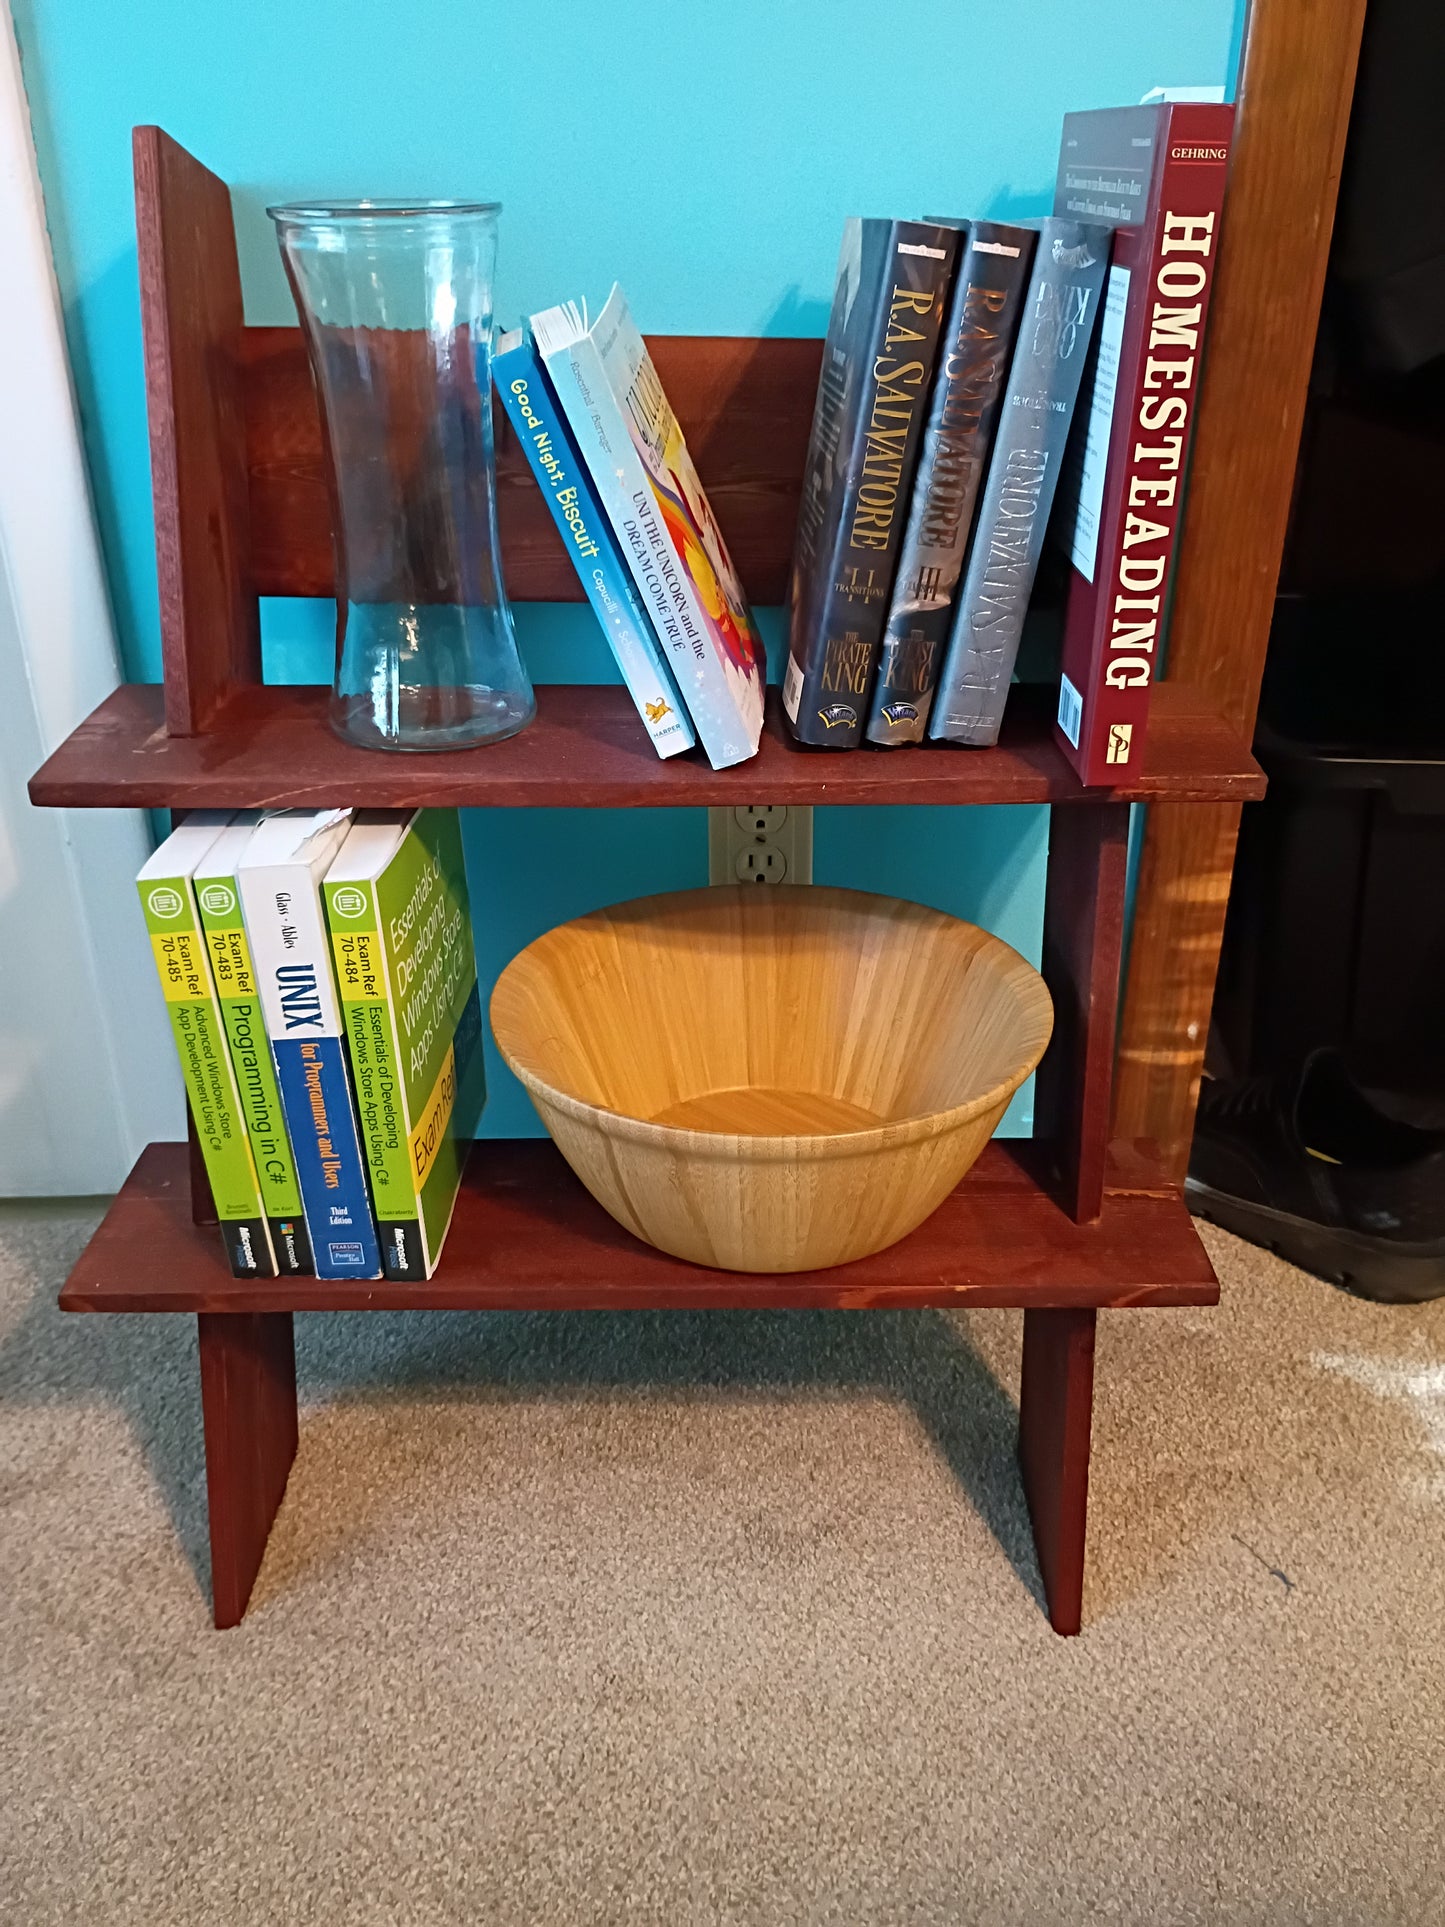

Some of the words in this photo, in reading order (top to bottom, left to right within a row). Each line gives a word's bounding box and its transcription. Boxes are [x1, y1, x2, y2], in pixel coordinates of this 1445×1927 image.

[1172, 148, 1226, 159] GEHRING
[570, 361, 594, 406] Rosenthal
[510, 378, 544, 430] Good
[533, 431, 566, 487] Night,
[556, 486, 600, 558] Biscuit
[850, 356, 925, 550] SALVATORE
[917, 352, 996, 550] SALVATORE
[1105, 210, 1215, 690] HOMESTEADING
[970, 449, 1050, 634] SALVATORE
[592, 568, 618, 614] Capucilli
[623, 520, 654, 572] DREAM
[646, 574, 672, 616] COME
[663, 616, 686, 652] TRUE
[632, 490, 652, 518] UNI
[644, 516, 664, 550] THE
[656, 549, 689, 612] UNICORN
[681, 611, 700, 638] and
[692, 634, 706, 660] the
[835, 582, 885, 598] TRANSITIONS
[826, 640, 872, 664] PIRATE
[821, 662, 868, 694] KING
[653, 724, 681, 738] HARPER
[276, 892, 291, 915] Glass
[390, 864, 433, 954] Essentials
[212, 934, 233, 980] 70-483
[281, 924, 298, 949] Ables
[358, 936, 370, 972] Exam
[396, 894, 446, 998] Developing
[161, 937, 182, 982] 70-485
[177, 936, 194, 971] Exam
[186, 974, 203, 995] Ref
[228, 933, 244, 968] Exam
[236, 972, 253, 992] Ref
[340, 936, 360, 984] 70-484
[402, 948, 444, 1038] Windows
[442, 908, 462, 959] Store
[276, 964, 324, 1030] UNIX
[362, 975, 378, 996] Ref
[351, 1007, 368, 1064] Windows
[369, 1006, 390, 1064] Essentials
[410, 1022, 434, 1082] Apps
[432, 973, 454, 1027] Using
[454, 944, 464, 980] C#
[194, 1006, 216, 1060] Advanced
[206, 1061, 225, 1110] Windows
[218, 1112, 232, 1140] Store
[232, 1004, 272, 1132] Programming
[300, 1042, 320, 1060] for
[378, 1066, 393, 1080] of
[176, 1007, 192, 1030] App
[184, 1032, 210, 1104] Development
[202, 1105, 216, 1135] Using
[210, 1136, 222, 1152] C#
[304, 1061, 330, 1136] Programmers
[360, 1067, 374, 1098] Store
[363, 1100, 378, 1132] Apps
[380, 1082, 400, 1149] Developing
[413, 1104, 444, 1177] Exam
[440, 1056, 456, 1106] Ref
[260, 1138, 280, 1154] in
[318, 1138, 340, 1159] and
[370, 1134, 386, 1168] Using
[265, 1160, 288, 1184] C#
[322, 1160, 342, 1189] Users
[376, 1169, 390, 1186] C#
[329, 1216, 352, 1225] Edition
[330, 1206, 348, 1216] Third
[238, 1226, 256, 1270] Microsoft
[285, 1235, 300, 1269] Microsoft
[394, 1228, 409, 1270] Microsoft
